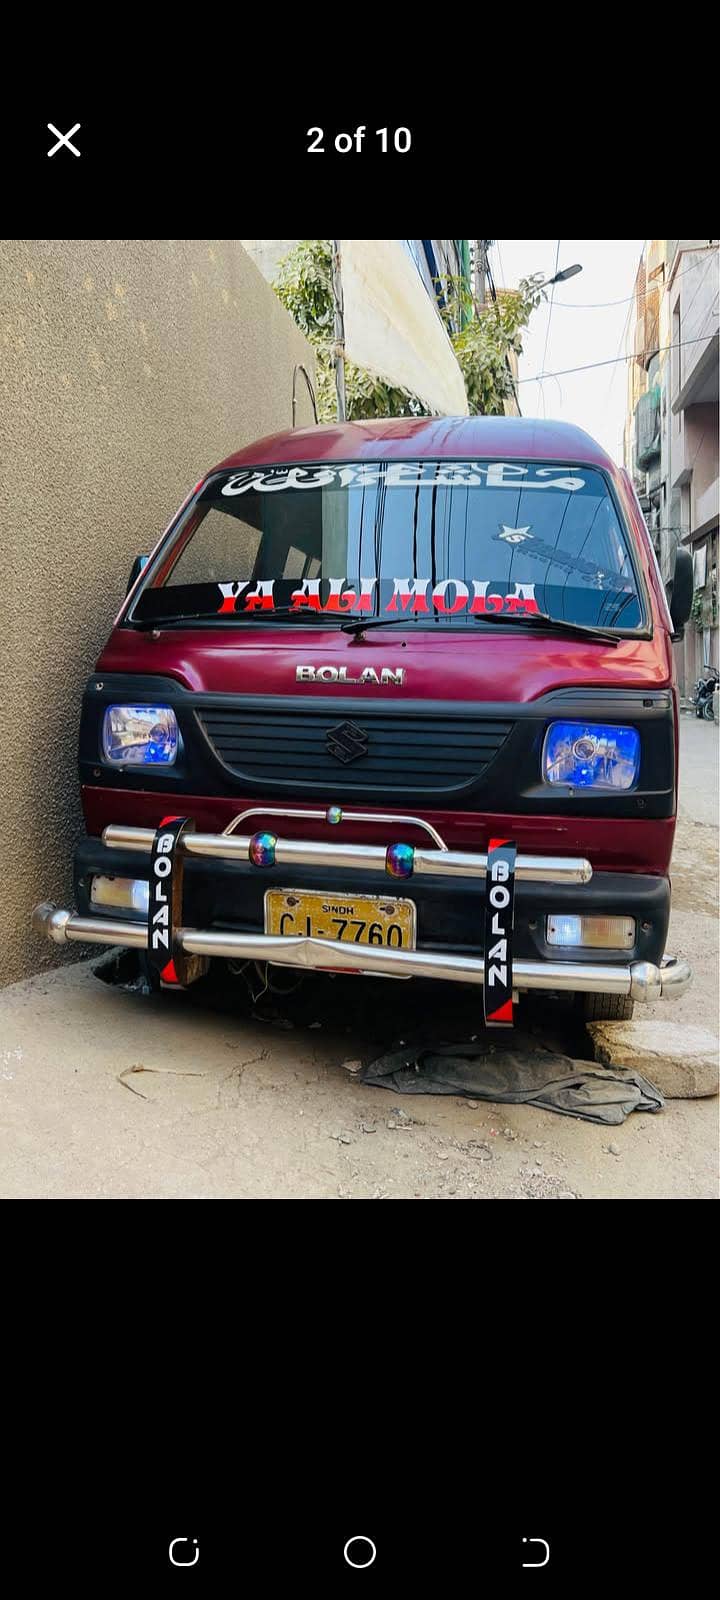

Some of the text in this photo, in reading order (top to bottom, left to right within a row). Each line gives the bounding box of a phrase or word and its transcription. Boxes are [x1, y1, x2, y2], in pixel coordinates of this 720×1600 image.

[217, 577, 540, 615] YA ALI MOLA
[295, 665, 405, 686] BOLAN
[152, 833, 175, 950] BOLAN
[321, 904, 354, 915] SINDH
[488, 860, 511, 988] BOLAN
